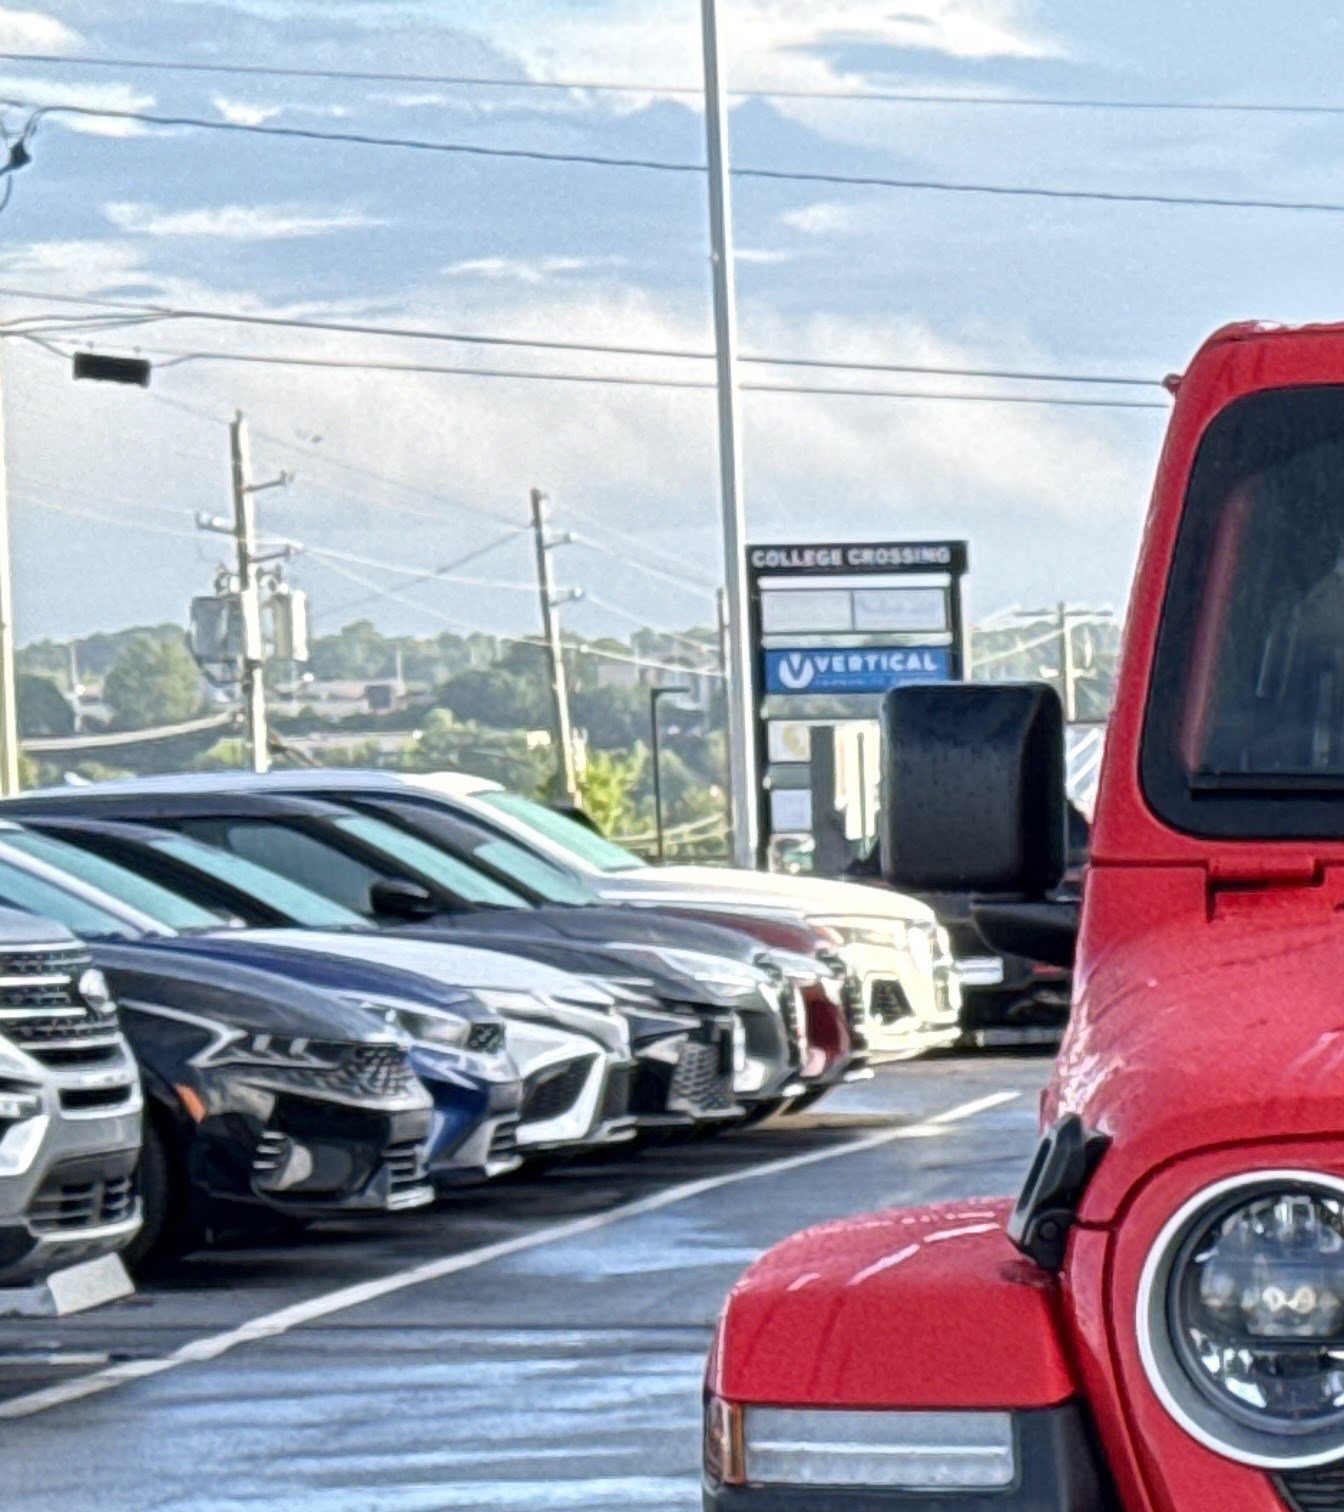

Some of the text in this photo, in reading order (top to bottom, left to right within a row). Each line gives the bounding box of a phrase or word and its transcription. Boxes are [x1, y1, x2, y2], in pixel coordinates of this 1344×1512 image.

[752, 546, 951, 567] COLLEGE CROSSING
[814, 652, 938, 673] VERTICAL
